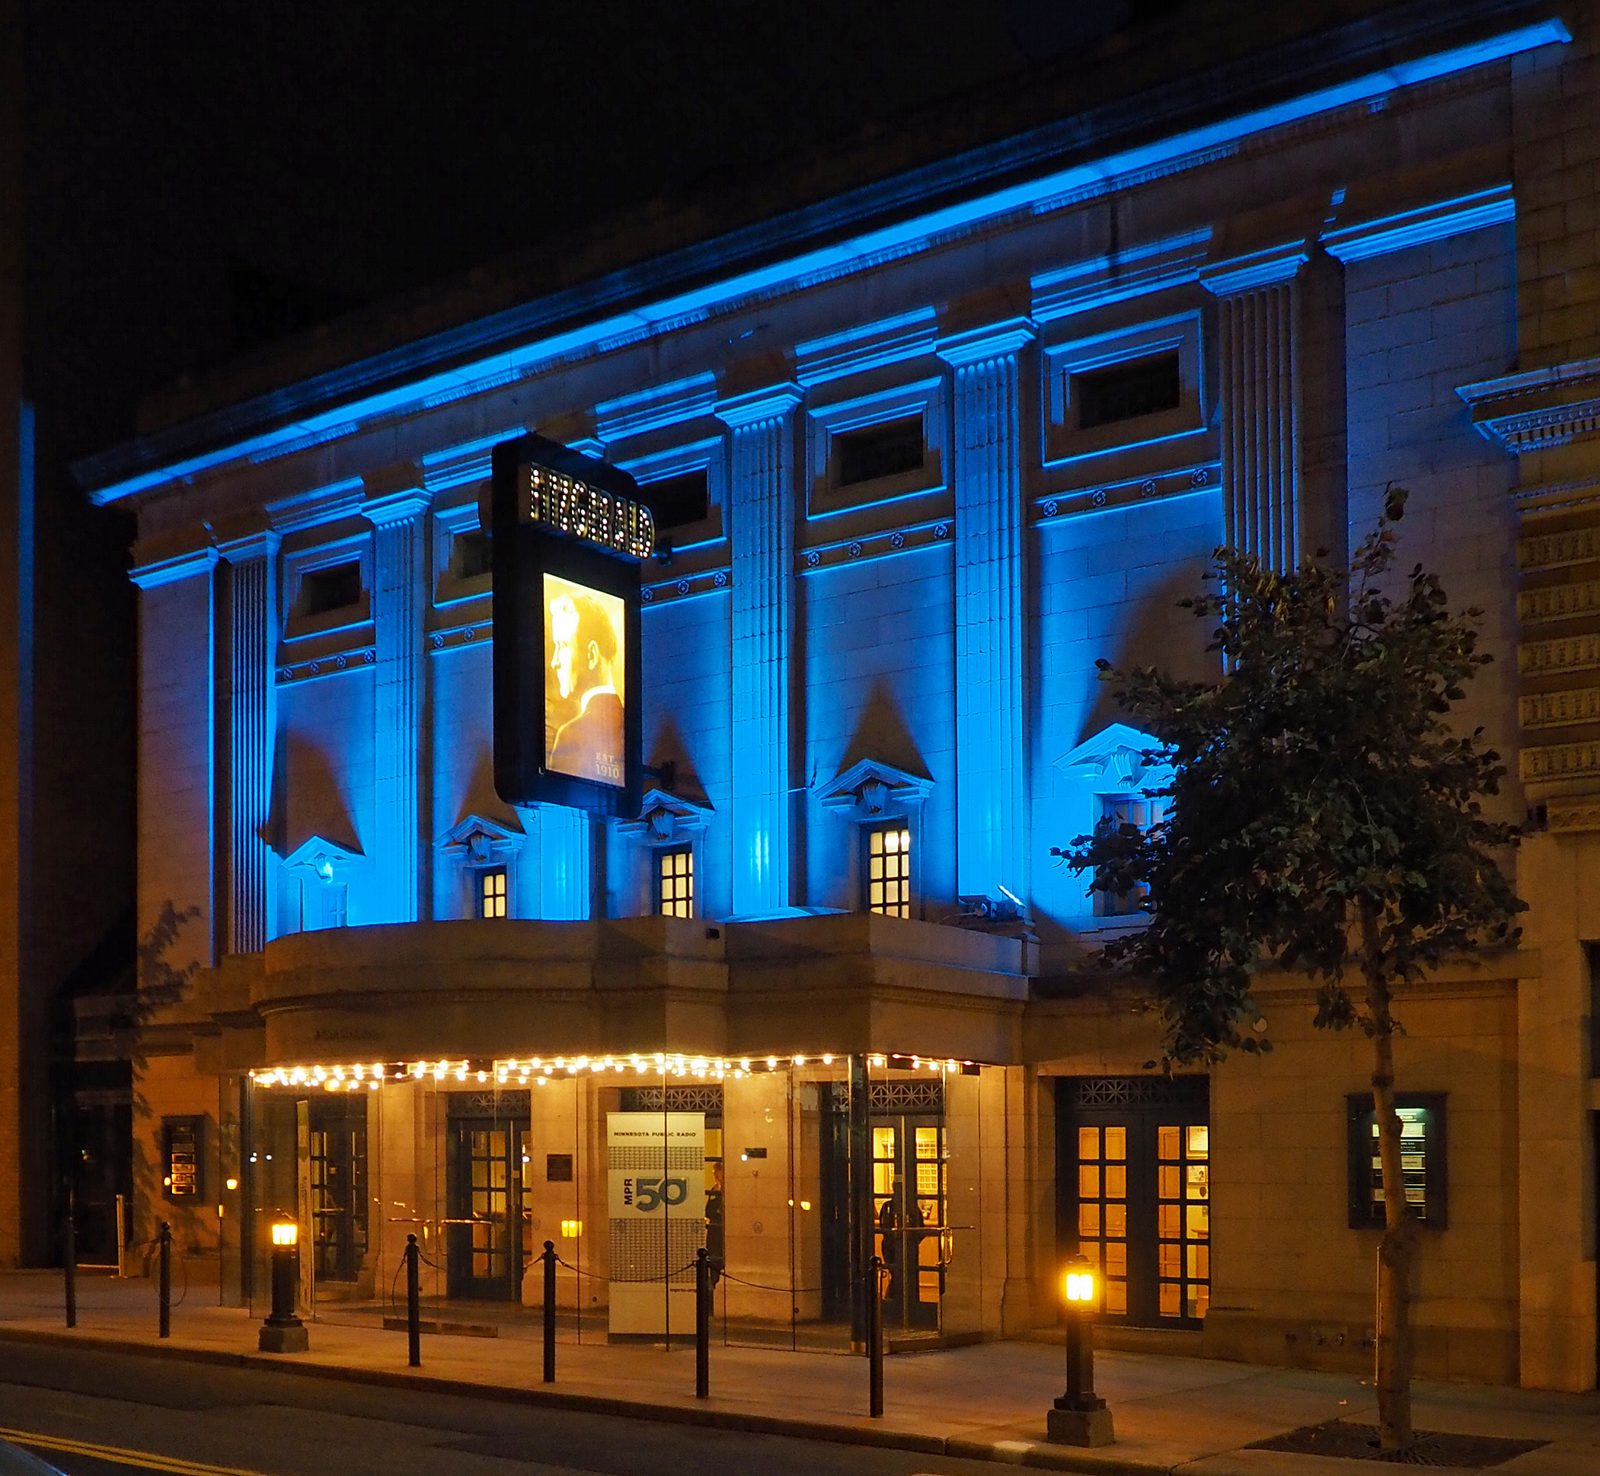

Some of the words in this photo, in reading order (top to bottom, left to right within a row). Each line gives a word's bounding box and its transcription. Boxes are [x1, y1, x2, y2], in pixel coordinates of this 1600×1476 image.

[530, 461, 656, 559] FITZGERALD
[596, 752, 618, 764] EST.
[596, 764, 620, 779] 1910
[624, 1178, 633, 1205] MPR
[636, 1177, 688, 1212] 50
